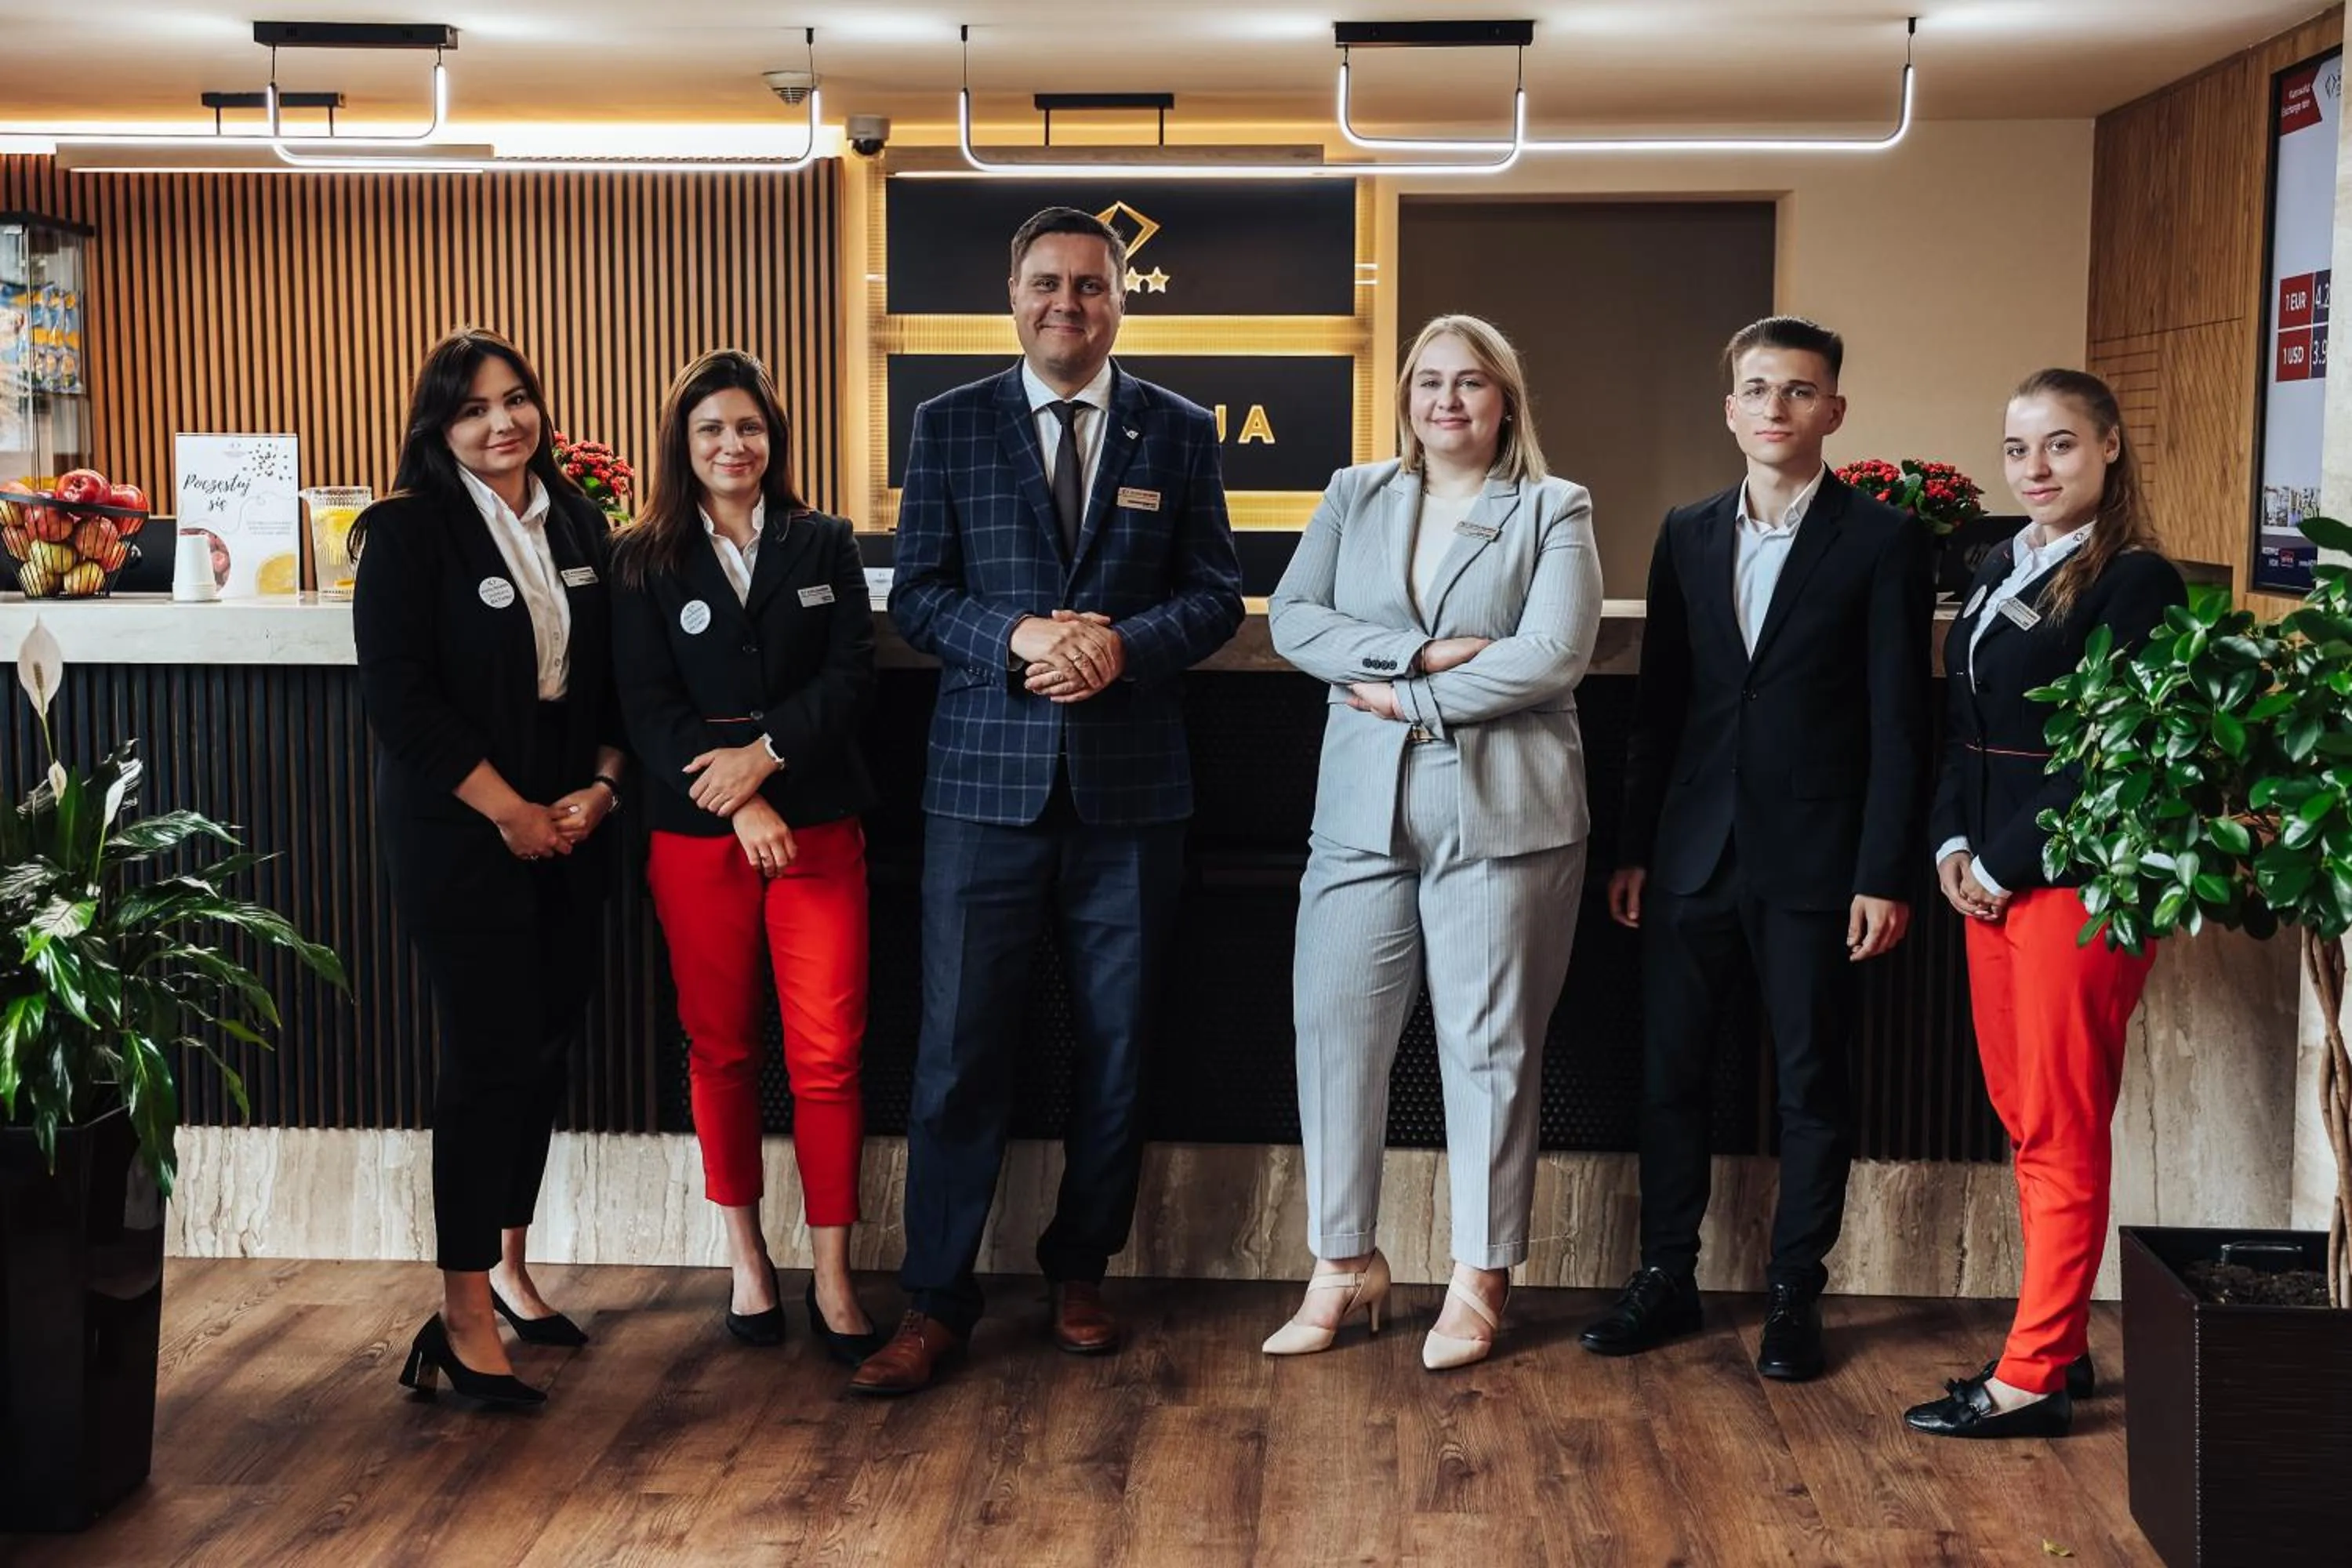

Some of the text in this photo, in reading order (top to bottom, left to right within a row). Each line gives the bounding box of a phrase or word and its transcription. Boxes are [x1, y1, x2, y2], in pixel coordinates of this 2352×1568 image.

[2290, 291, 2307, 311] EUR
[2287, 346, 2304, 365] USD
[183, 474, 252, 495] Poczęstuj
[208, 497, 227, 512] się
